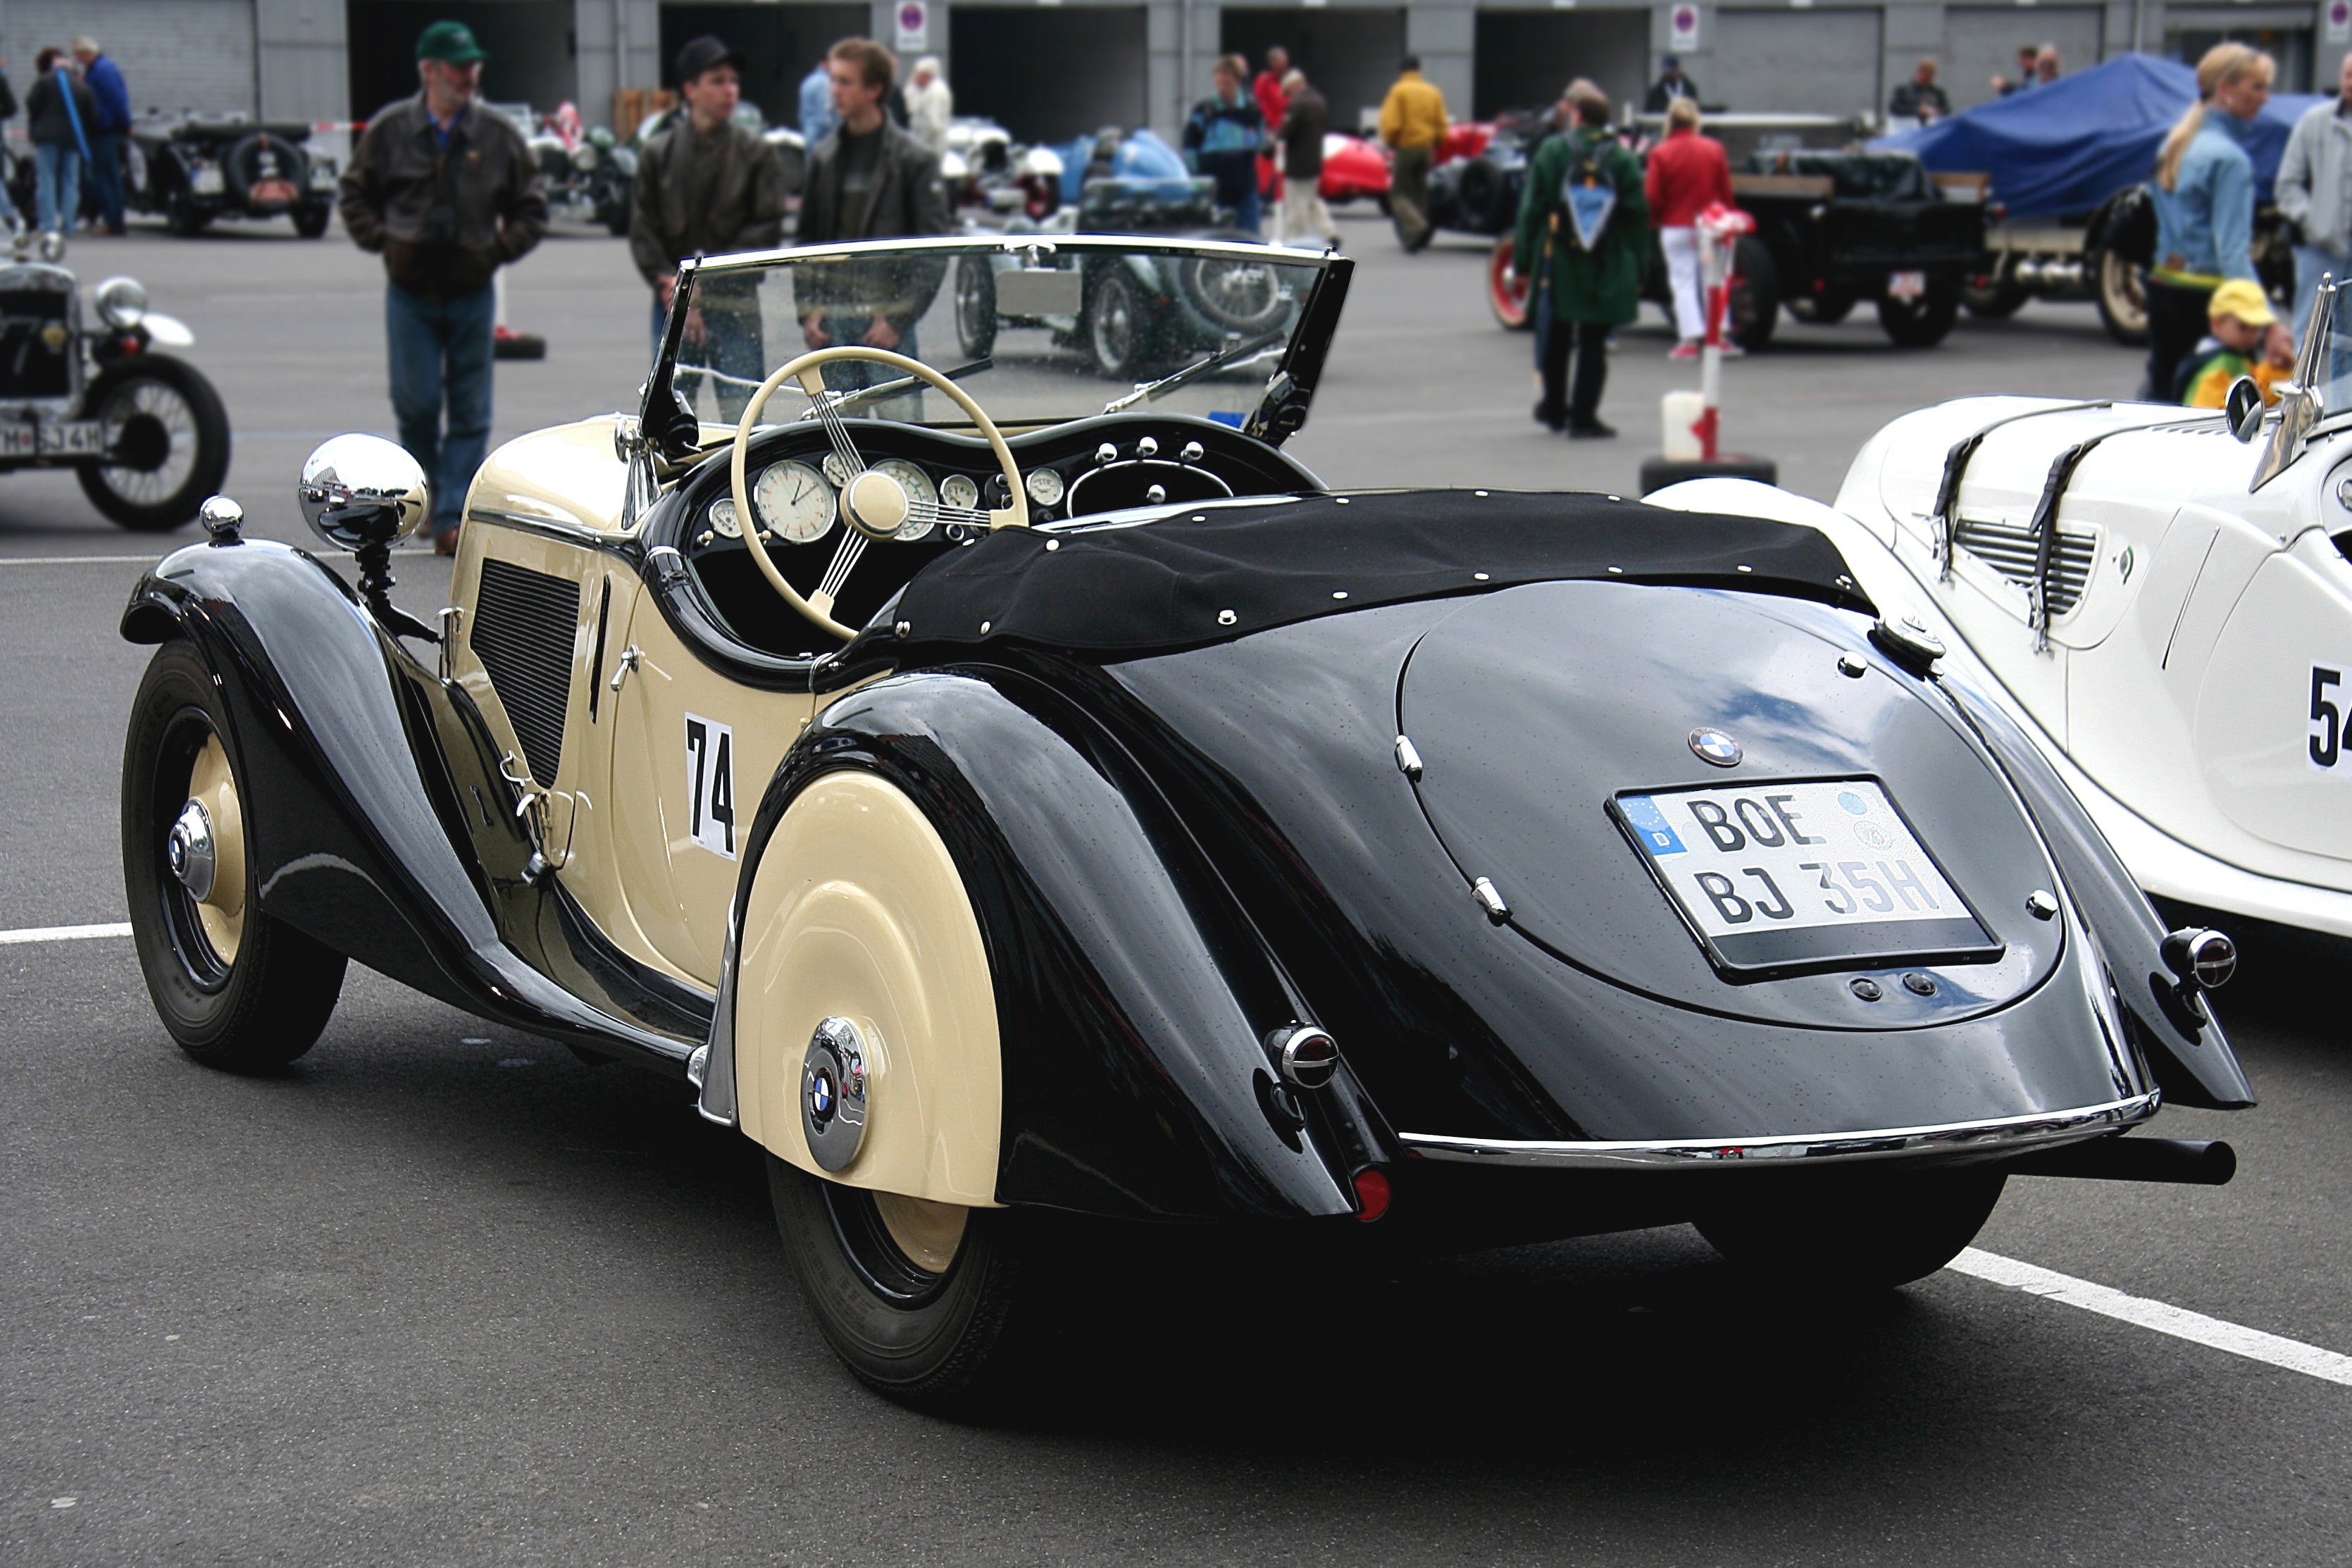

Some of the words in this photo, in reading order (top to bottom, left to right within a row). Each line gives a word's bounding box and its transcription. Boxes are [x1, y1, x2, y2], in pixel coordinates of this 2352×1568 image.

[686, 718, 734, 854] 74
[1651, 832, 1671, 847] D
[1686, 795, 1827, 852] BOE
[1693, 866, 1795, 925] BJ
[1799, 859, 1941, 914] 35H
